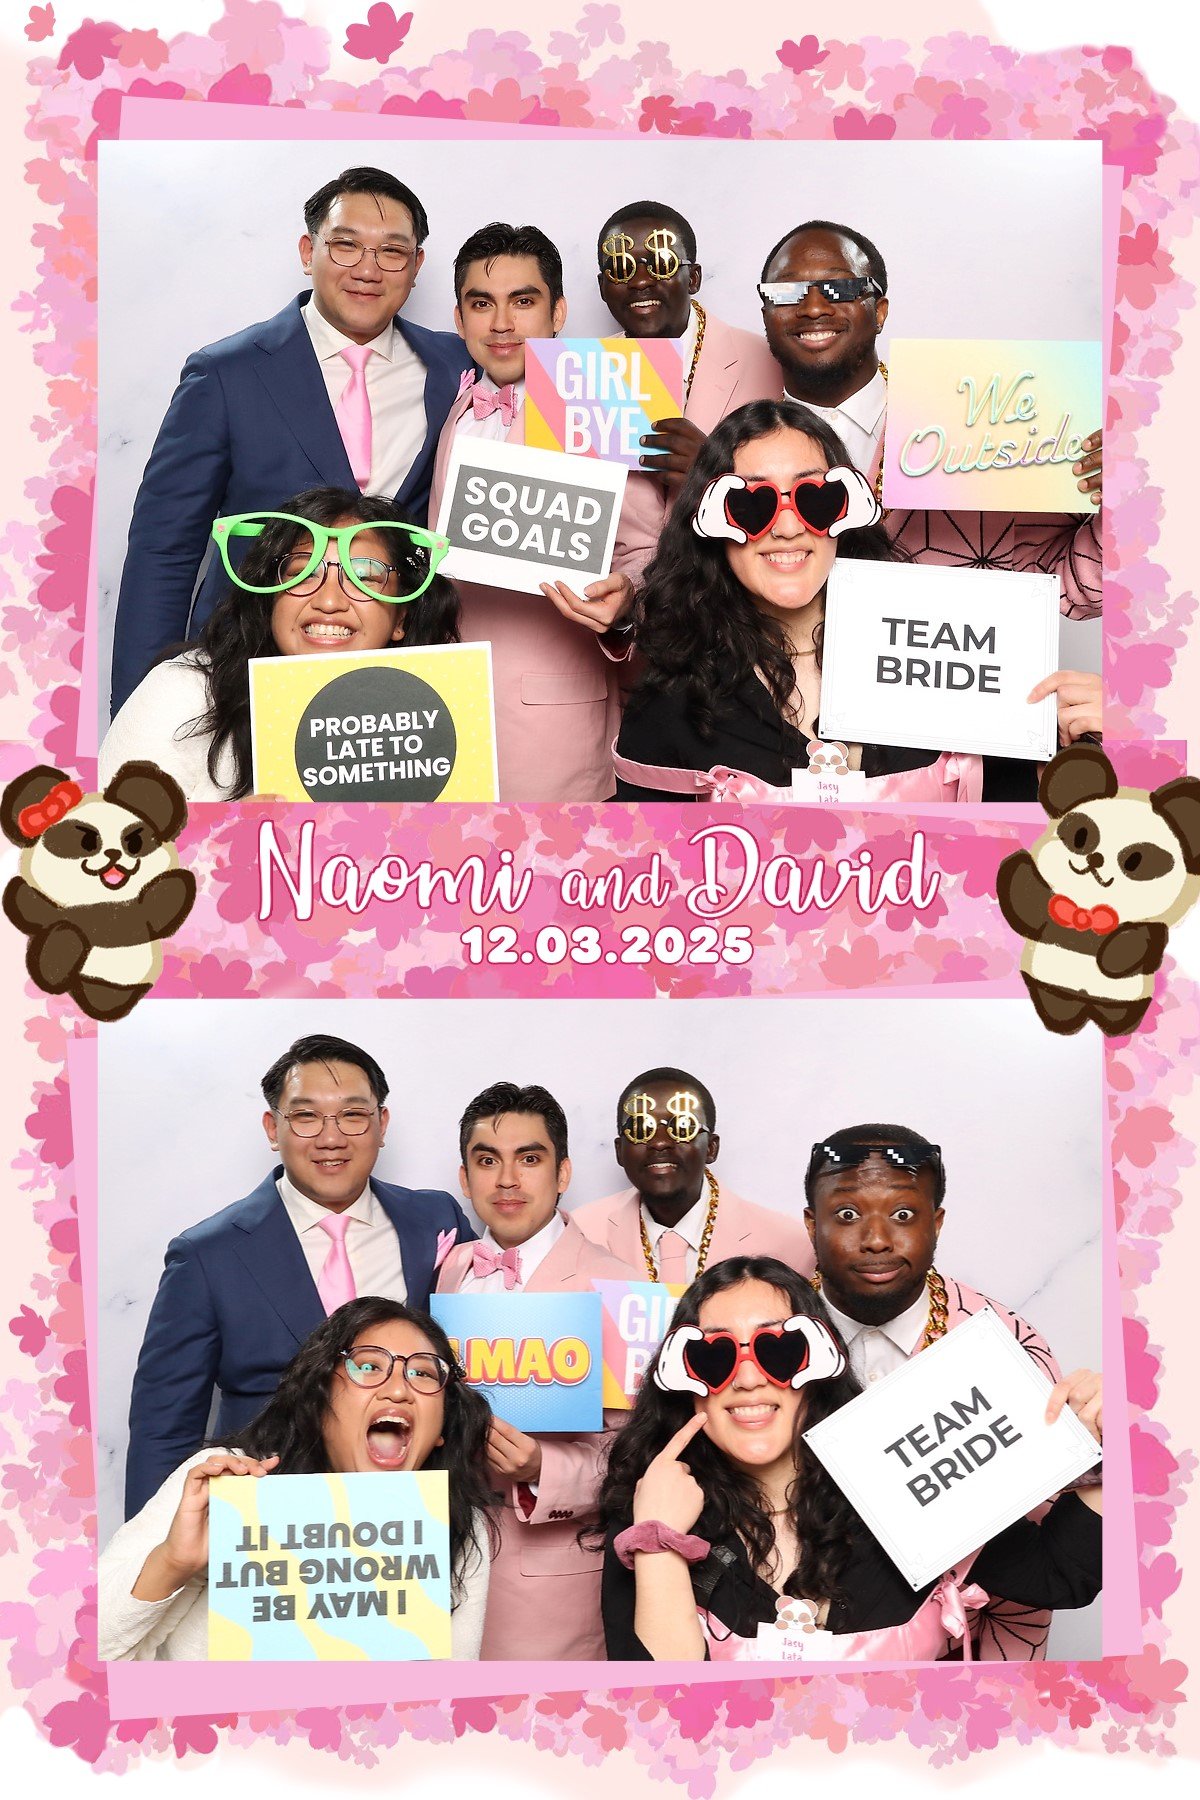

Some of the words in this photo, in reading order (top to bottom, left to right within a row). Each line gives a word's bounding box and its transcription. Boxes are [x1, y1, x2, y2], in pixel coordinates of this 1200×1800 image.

[555, 350, 651, 401] GIRL
[957, 369, 1038, 427] We
[564, 405, 641, 455] BYE
[899, 412, 1084, 478] Outside
[464, 476, 602, 526] SQUAD
[461, 513, 592, 562] GOALS
[882, 617, 997, 655] TEAM
[875, 655, 1002, 695] BRIDE
[310, 709, 439, 738] PROBABLY
[326, 738, 384, 761] LATE
[389, 734, 423, 755] TO
[303, 757, 451, 787] SOMETHING
[619, 1293, 681, 1343] GI
[883, 1386, 992, 1468] TEAM
[906, 1414, 1023, 1507] BRIDE
[235, 1525, 269, 1552] IT
[280, 1520, 404, 1550] DOUBT
[413, 1519, 423, 1545] I
[215, 1560, 288, 1589] BUT
[299, 1554, 441, 1585] WRONG
[252, 1595, 296, 1622] BE
[307, 1590, 388, 1619] MAY
[397, 1589, 407, 1615] I
